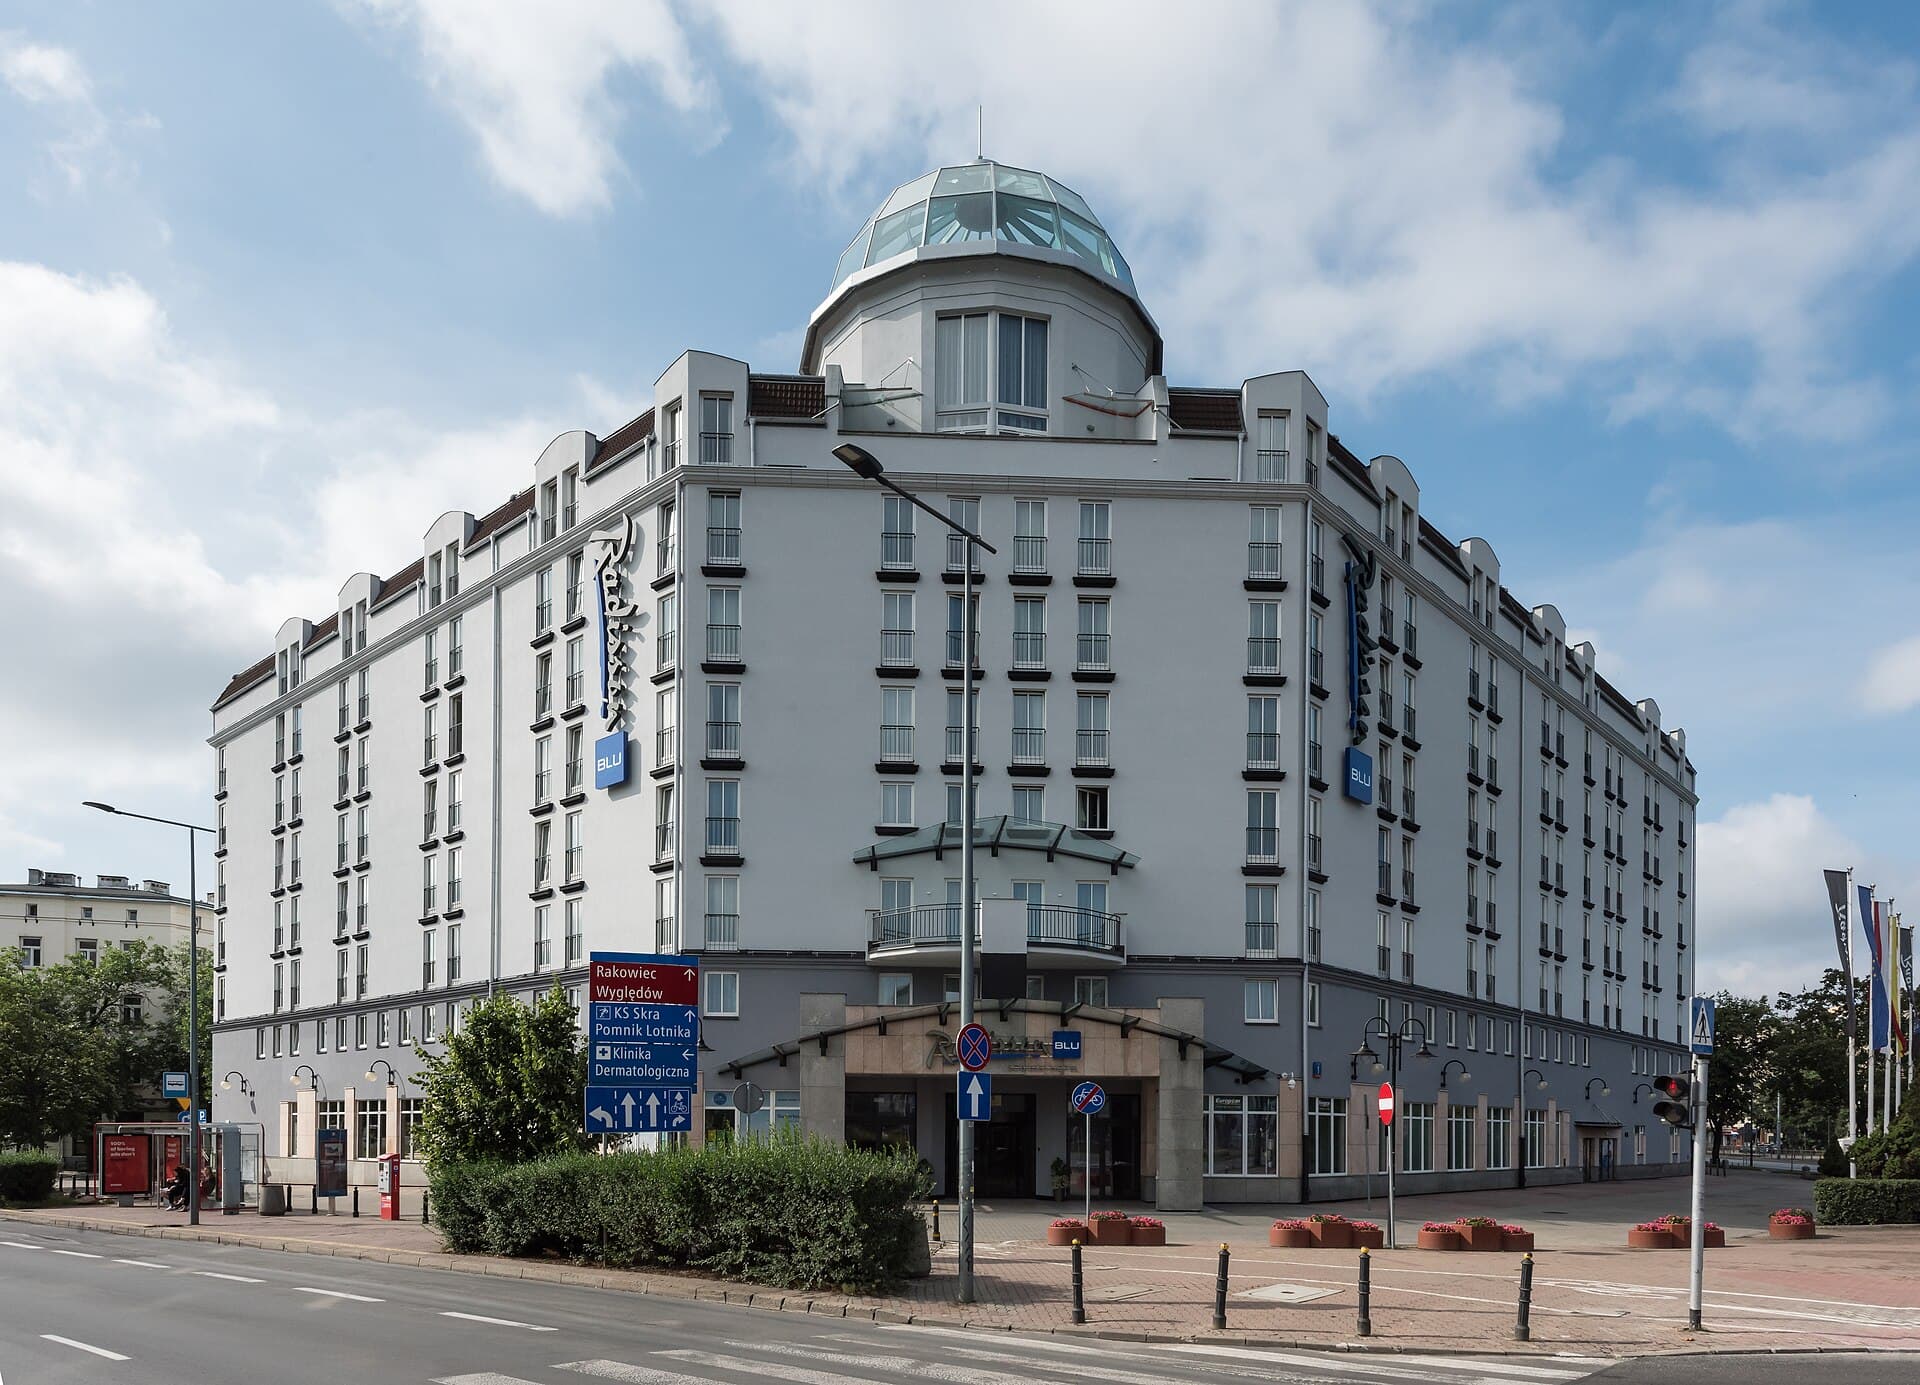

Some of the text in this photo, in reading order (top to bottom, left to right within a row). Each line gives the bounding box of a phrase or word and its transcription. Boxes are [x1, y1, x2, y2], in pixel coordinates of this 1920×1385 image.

[588, 512, 639, 732] Radisson
[597, 752, 622, 772] BLU
[1351, 768, 1371, 787] BLU
[596, 965, 657, 980] Rakowiec
[596, 985, 663, 1001] Wyględów
[614, 1006, 660, 1020] KS Skra
[595, 1023, 691, 1038] Pomnik Lotnika
[1054, 1041, 1080, 1050] BLU
[613, 1047, 651, 1060] Klinika
[595, 1064, 689, 1080] Dermatologiczna
